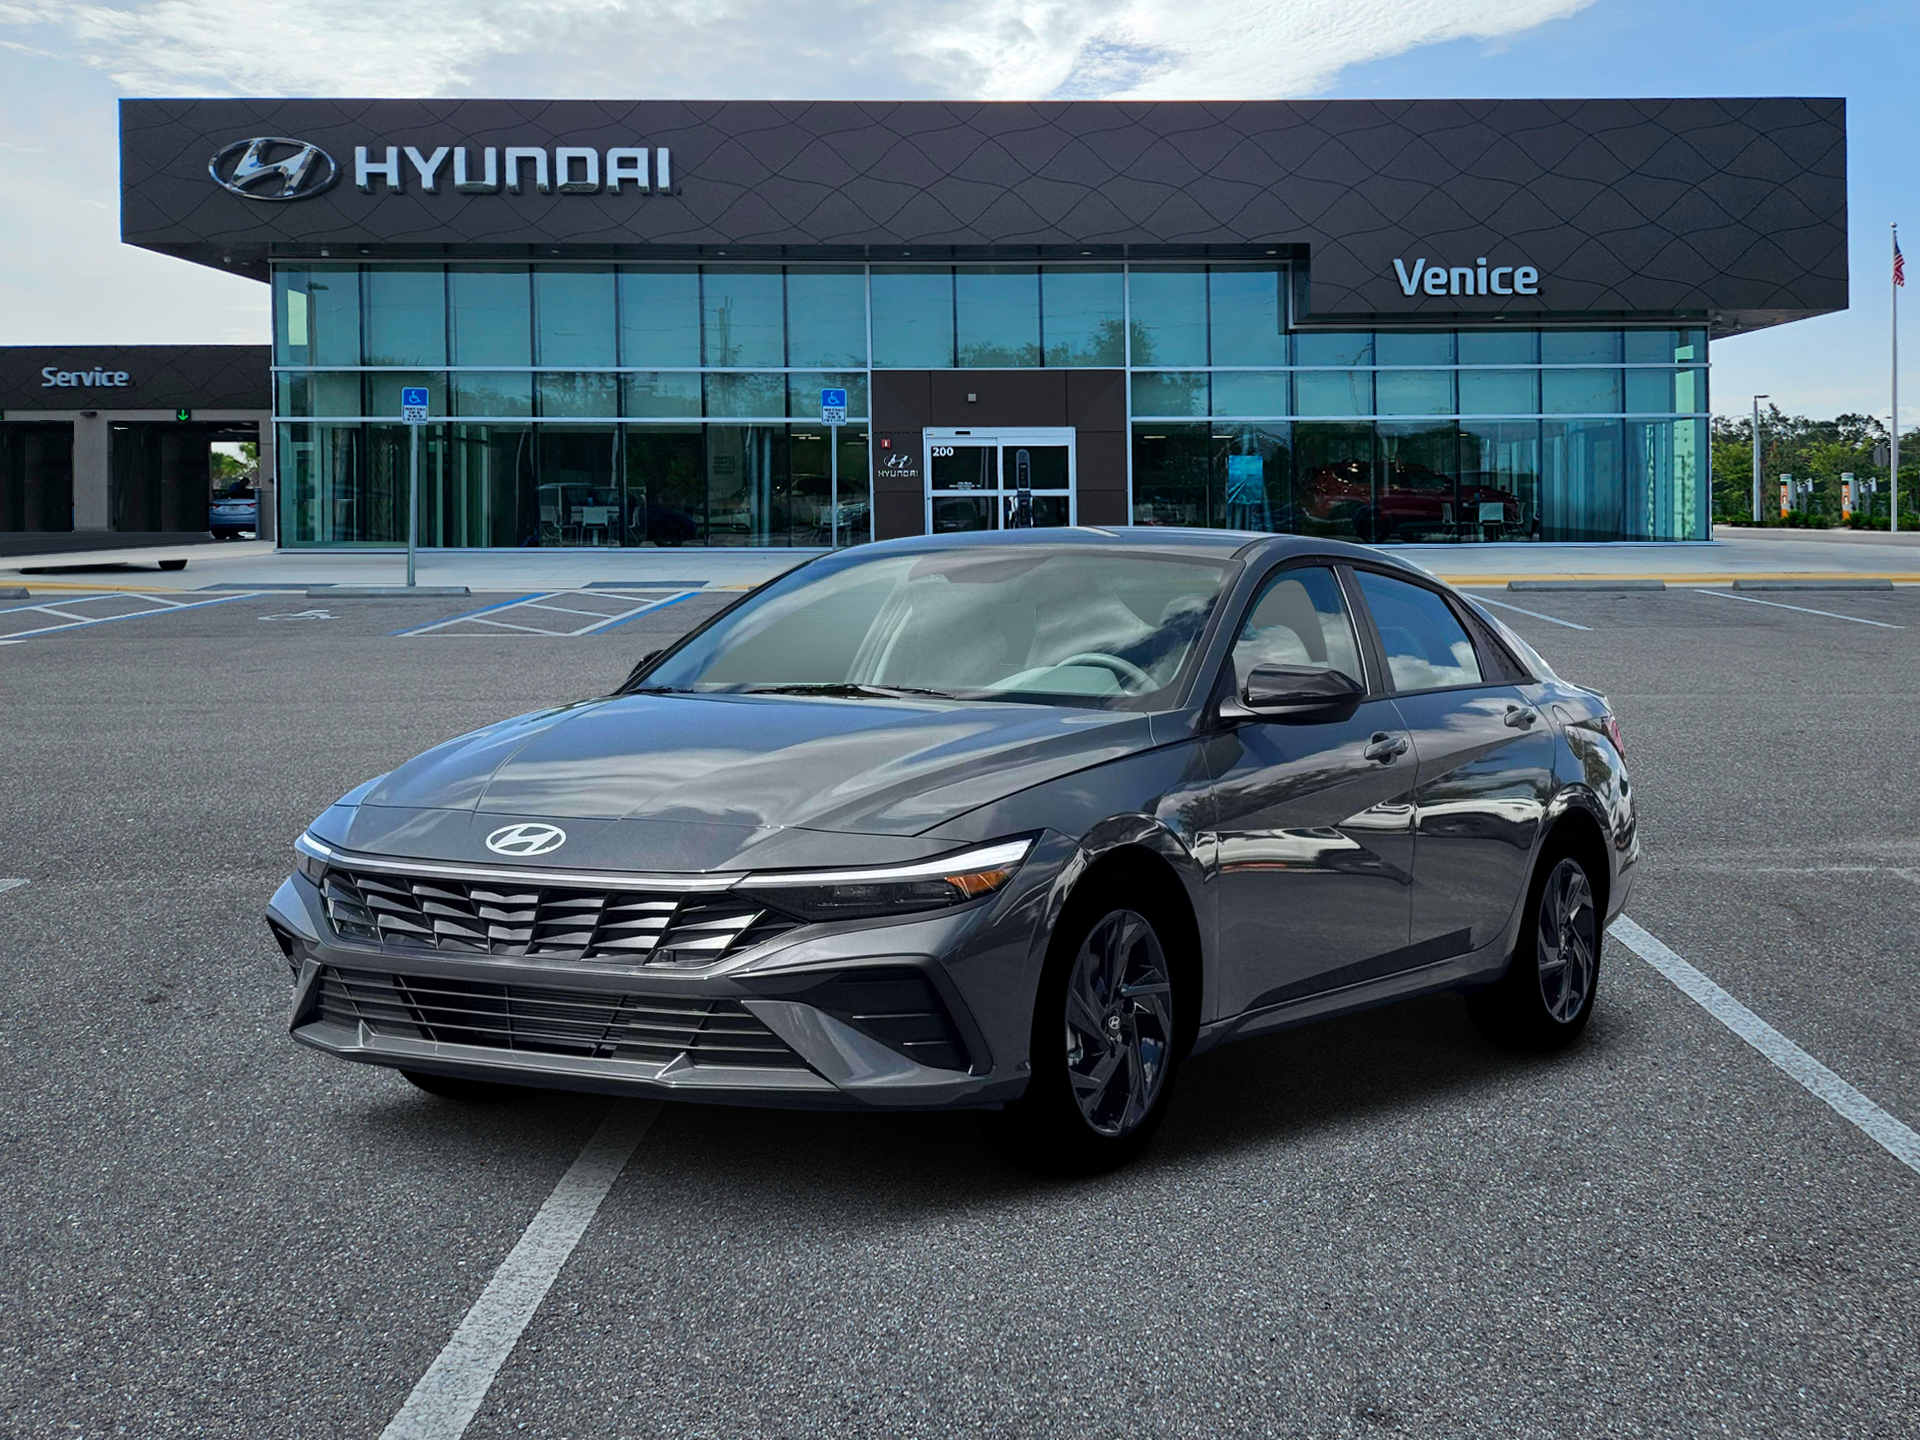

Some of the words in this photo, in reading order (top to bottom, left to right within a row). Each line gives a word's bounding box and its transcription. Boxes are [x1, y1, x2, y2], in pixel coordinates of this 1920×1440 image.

[355, 146, 670, 194] HYUNDAI
[1393, 257, 1538, 295] Venice
[41, 366, 130, 387] Service
[932, 447, 954, 457] 200
[877, 470, 919, 478] HYUNDAI
